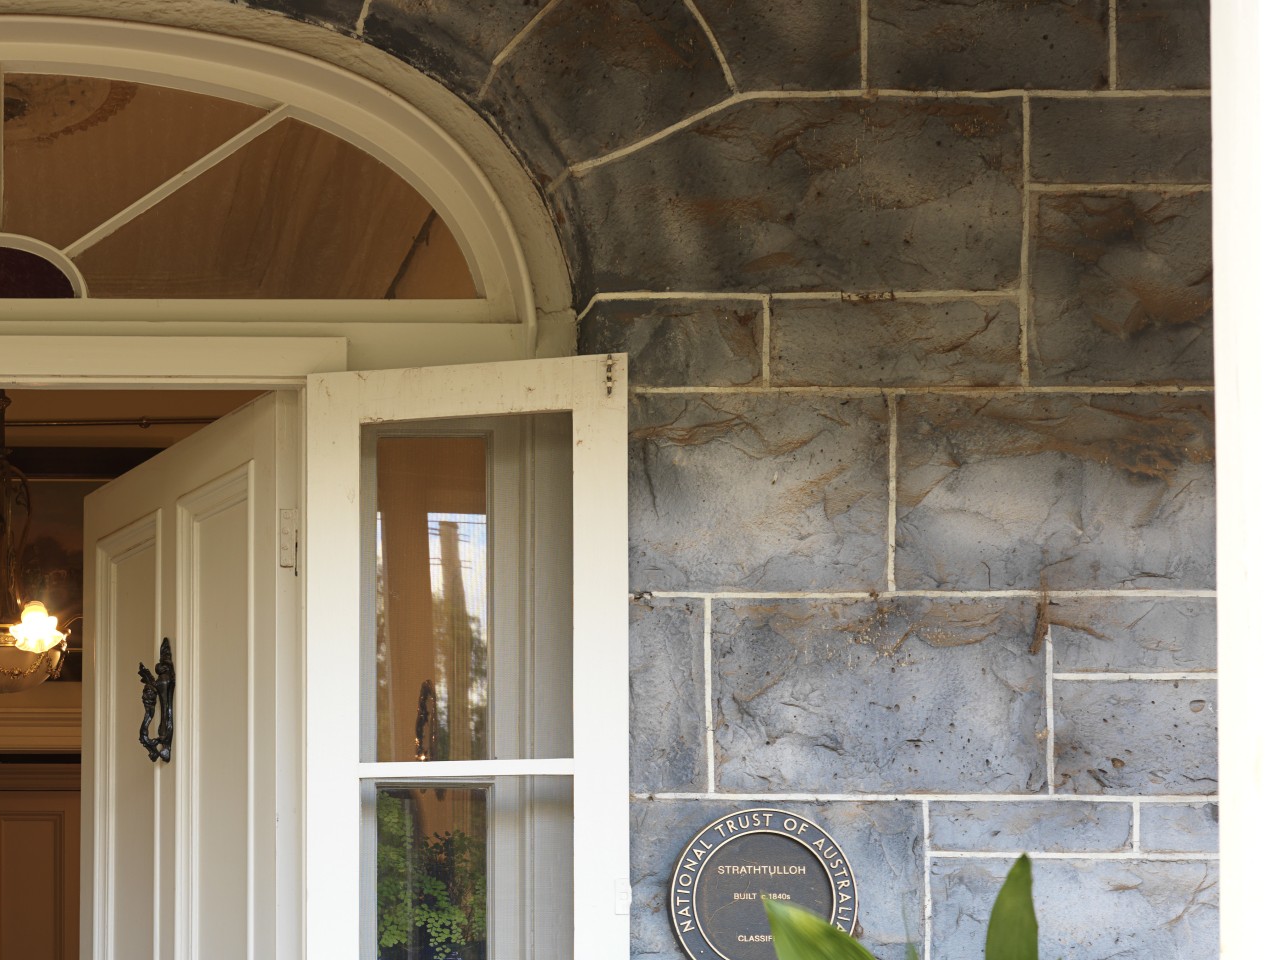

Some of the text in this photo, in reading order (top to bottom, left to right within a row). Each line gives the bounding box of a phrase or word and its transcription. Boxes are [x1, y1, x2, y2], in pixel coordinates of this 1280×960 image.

[677, 813, 852, 933] NATIONAL TRUST OF AUSTRALIA
[717, 865, 806, 875] STRATHTULLOH
[733, 892, 757, 900] BUILT
[737, 934, 775, 942] CLASSIF
